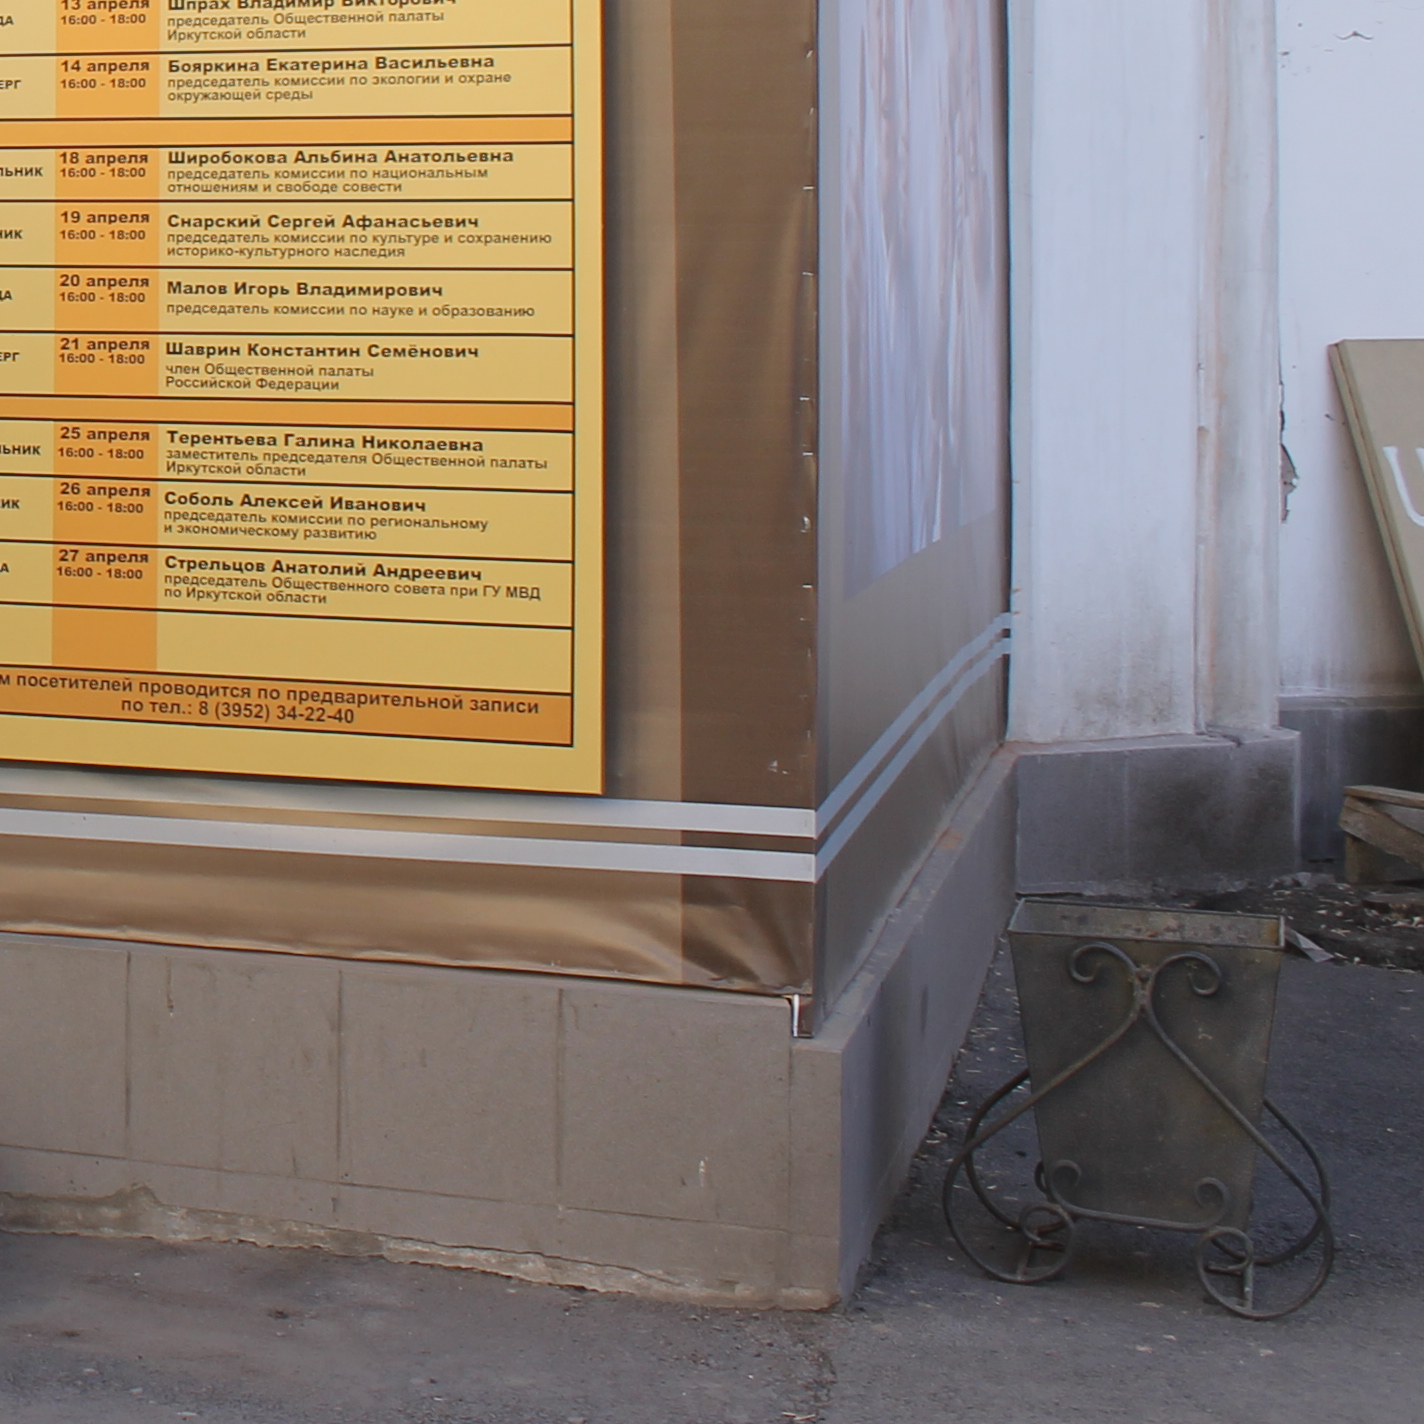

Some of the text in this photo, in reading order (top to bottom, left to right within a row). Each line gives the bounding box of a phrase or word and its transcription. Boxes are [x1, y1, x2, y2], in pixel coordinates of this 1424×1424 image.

[86, 0, 149, 12] апреля
[61, 59, 148, 74] 14 апреля
[168, 56, 493, 75] Бояркина Екатерина Васильевна
[59, 151, 147, 168] 18 апреля
[168, 149, 512, 167] Широбокова Альбина Анатольевна
[60, 211, 149, 224] 19 апреля
[267, 214, 334, 230] Сергей
[342, 214, 477, 230] Афанасьевич
[167, 245, 404, 259] историко-культурного наследия
[59, 274, 148, 290] 20 апреля
[167, 281, 442, 299] Малов Игорь Владимирович
[166, 304, 534, 319] председатель комиссии по науке и образованию
[60, 337, 149, 355] 21 апреля
[166, 342, 478, 358] Шаврин Константин Семёнович
[165, 363, 373, 380] член Общественной палаты
[166, 375, 338, 392] Российской Федерации
[60, 426, 149, 443] 25 апреля
[166, 430, 482, 452] Терентьева Галина Николаевна
[60, 482, 150, 499] 26 апреля
[164, 491, 425, 511] Соболь Алексей Иванович
[58, 549, 148, 565] 27 апреля
[165, 555, 480, 581] Стрельцов Анатолий Андреевич
[16, 675, 131, 691] посетителей
[139, 681, 250, 699] проводится
[258, 688, 279, 700] по
[286, 689, 462, 710] предварительной
[469, 699, 538, 713] записи
[121, 700, 143, 711] по
[198, 700, 208, 715] 8
[215, 701, 269, 722] (3952)
[276, 704, 353, 723] 34-22-40
